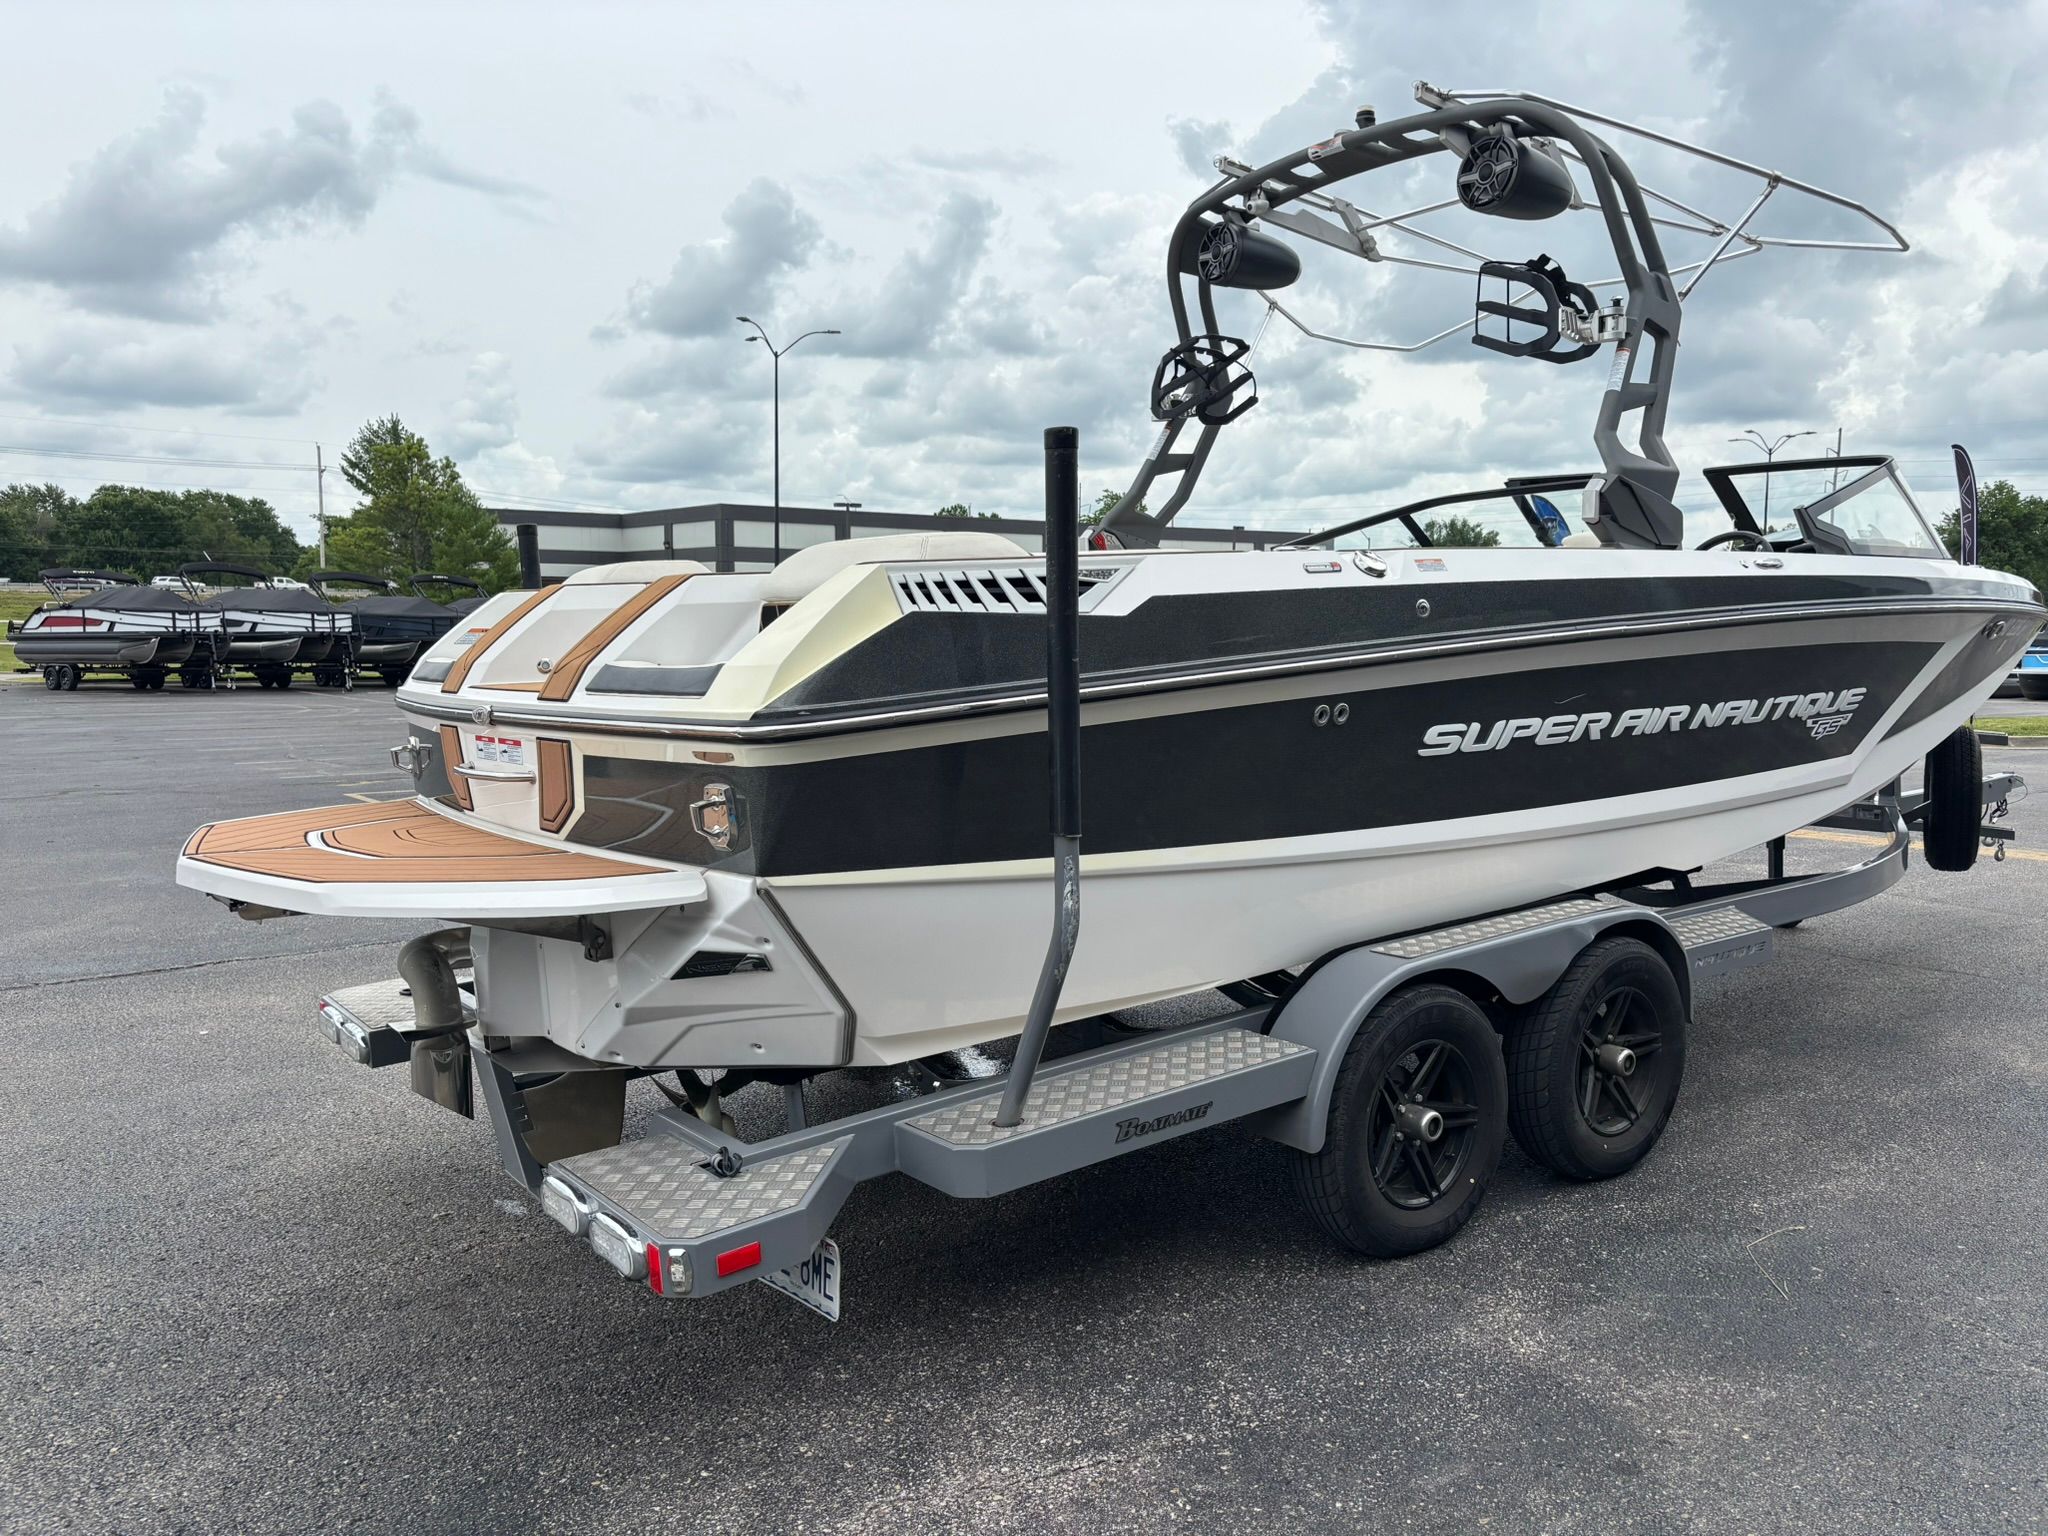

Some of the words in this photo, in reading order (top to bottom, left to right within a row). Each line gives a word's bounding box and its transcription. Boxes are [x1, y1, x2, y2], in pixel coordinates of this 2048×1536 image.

[1417, 711, 1612, 757] SUPER
[1611, 705, 1689, 736] AIR
[1690, 687, 1868, 730] NAUTIQUE
[1694, 941, 1766, 968] NAUTIQUE
